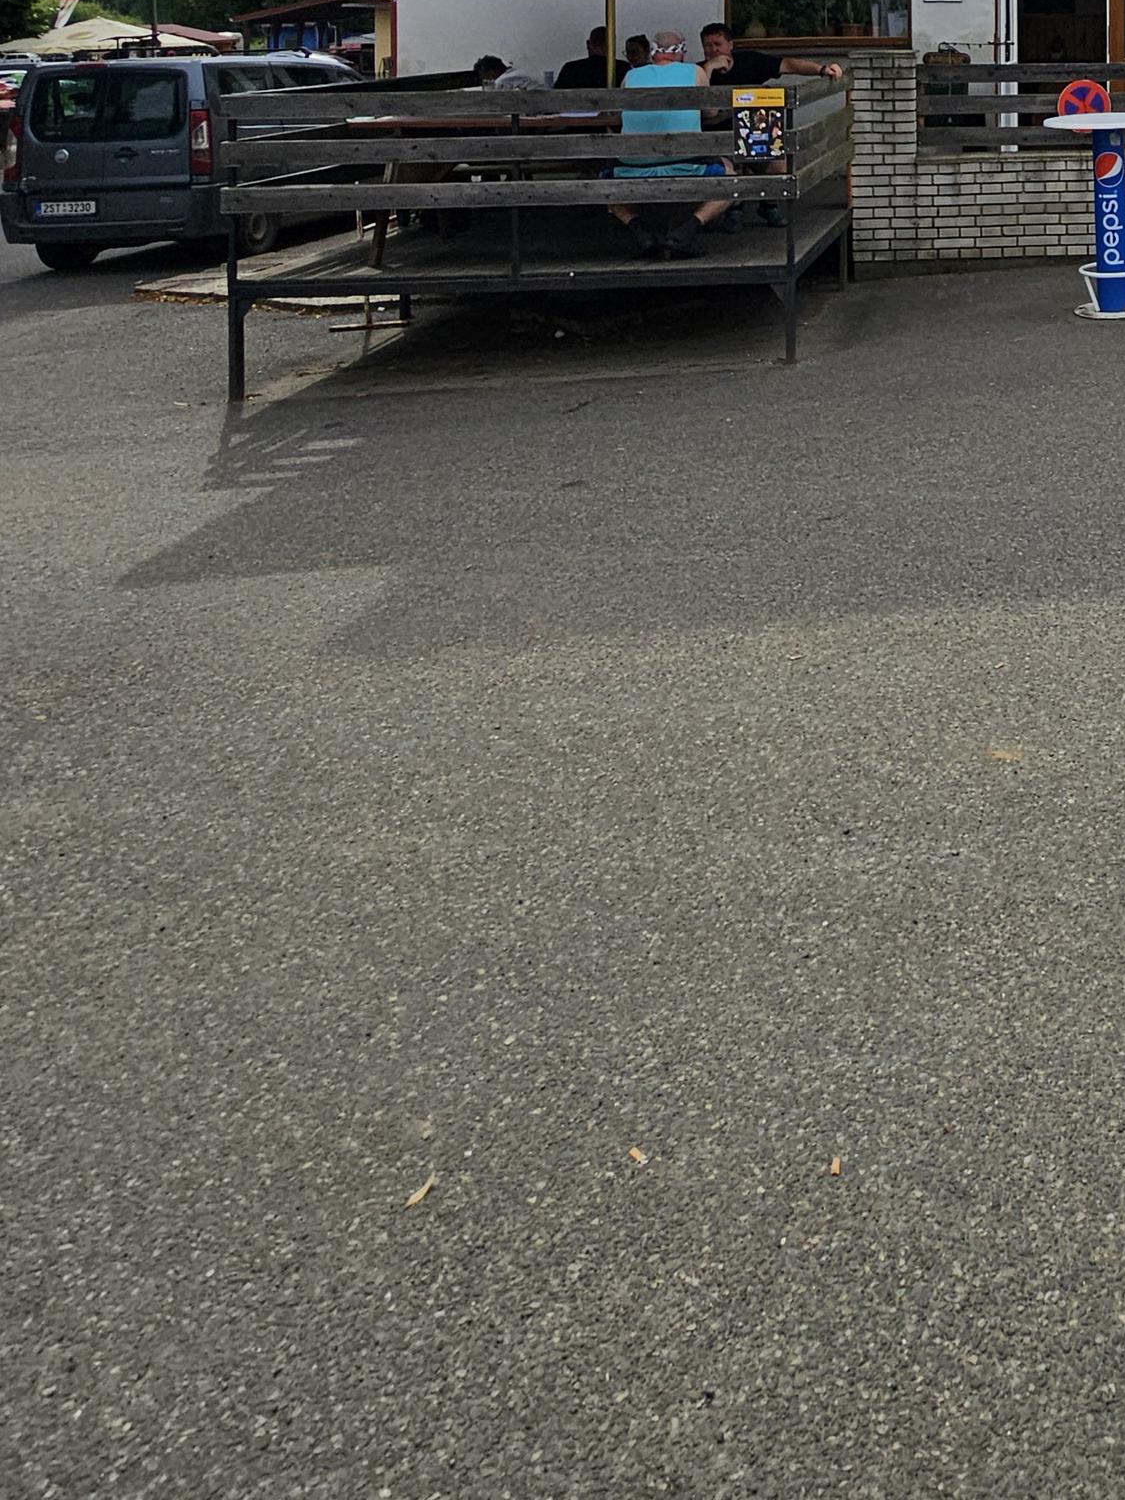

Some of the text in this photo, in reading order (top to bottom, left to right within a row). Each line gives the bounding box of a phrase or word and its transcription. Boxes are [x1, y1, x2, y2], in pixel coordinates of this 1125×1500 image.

[43, 203, 91, 213] 2ST 3230
[1099, 193, 1125, 265] pepsi
